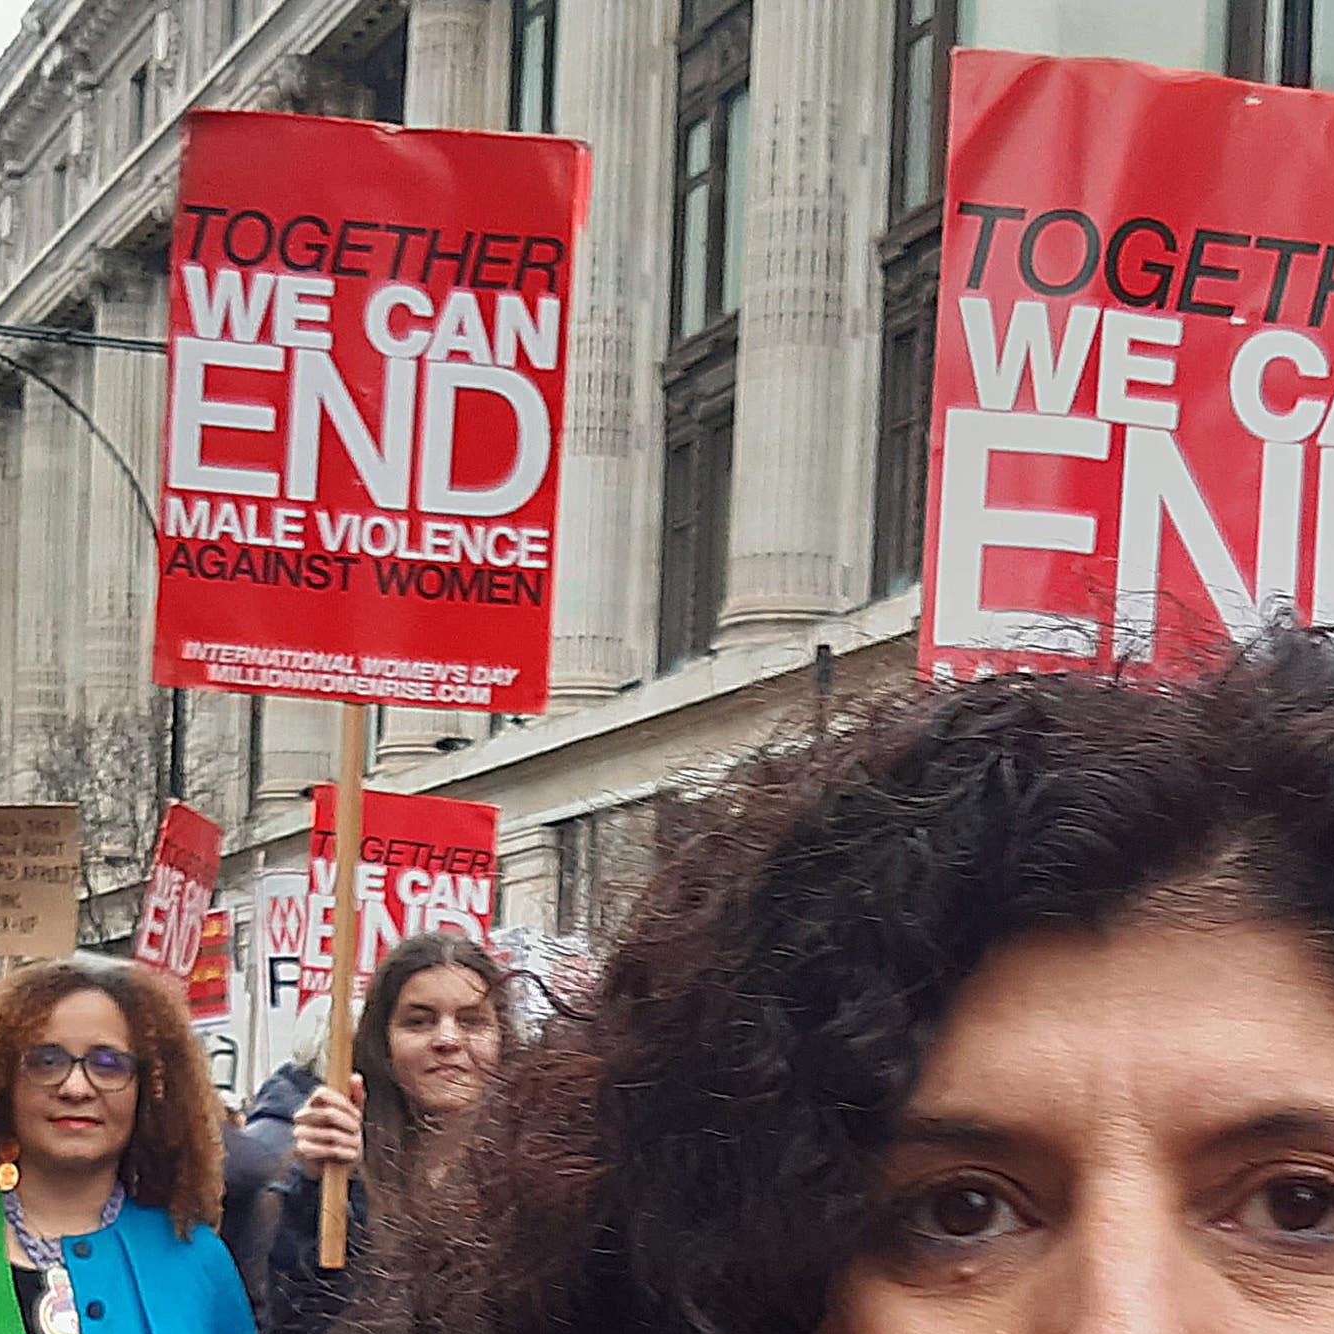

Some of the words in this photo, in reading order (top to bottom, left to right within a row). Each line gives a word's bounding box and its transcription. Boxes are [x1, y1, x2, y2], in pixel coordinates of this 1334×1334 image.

[182, 204, 564, 292] TOGETHER
[183, 264, 335, 351] WE
[366, 285, 560, 370] CAN
[959, 298, 1184, 431] WE
[168, 336, 551, 517] END
[166, 498, 307, 549] MALE
[315, 511, 550, 569] VIOLENCE
[166, 542, 361, 591] AGAINST
[375, 561, 545, 606] WOMEN
[181, 641, 357, 675] INTERNATIONAL
[361, 658, 469, 683] WOMEN'S
[471, 666, 521, 687] DAY
[207, 664, 492, 705] MILLIONWOMENRISE.COM
[314, 830, 492, 875] TGETHER
[396, 869, 491, 915] CAN
[135, 896, 203, 977] END
